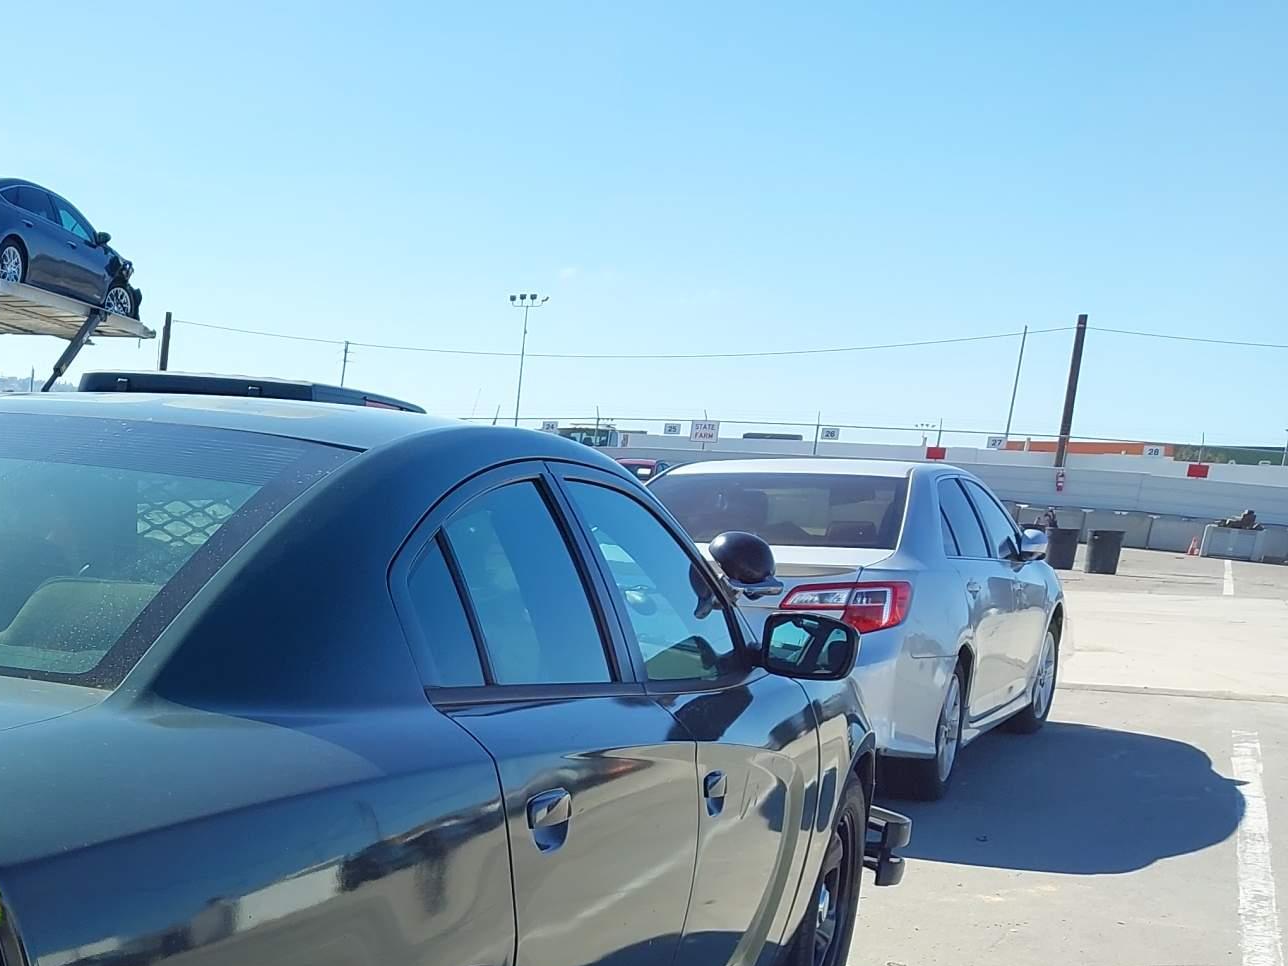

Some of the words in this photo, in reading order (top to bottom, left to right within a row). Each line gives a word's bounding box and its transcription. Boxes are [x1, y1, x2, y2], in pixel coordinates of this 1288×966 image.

[667, 425, 677, 433] 25
[695, 423, 716, 431] STATE
[694, 431, 714, 439] FARM
[824, 430, 836, 438] 26
[991, 439, 1002, 447] 27
[1147, 448, 1160, 456] 28
